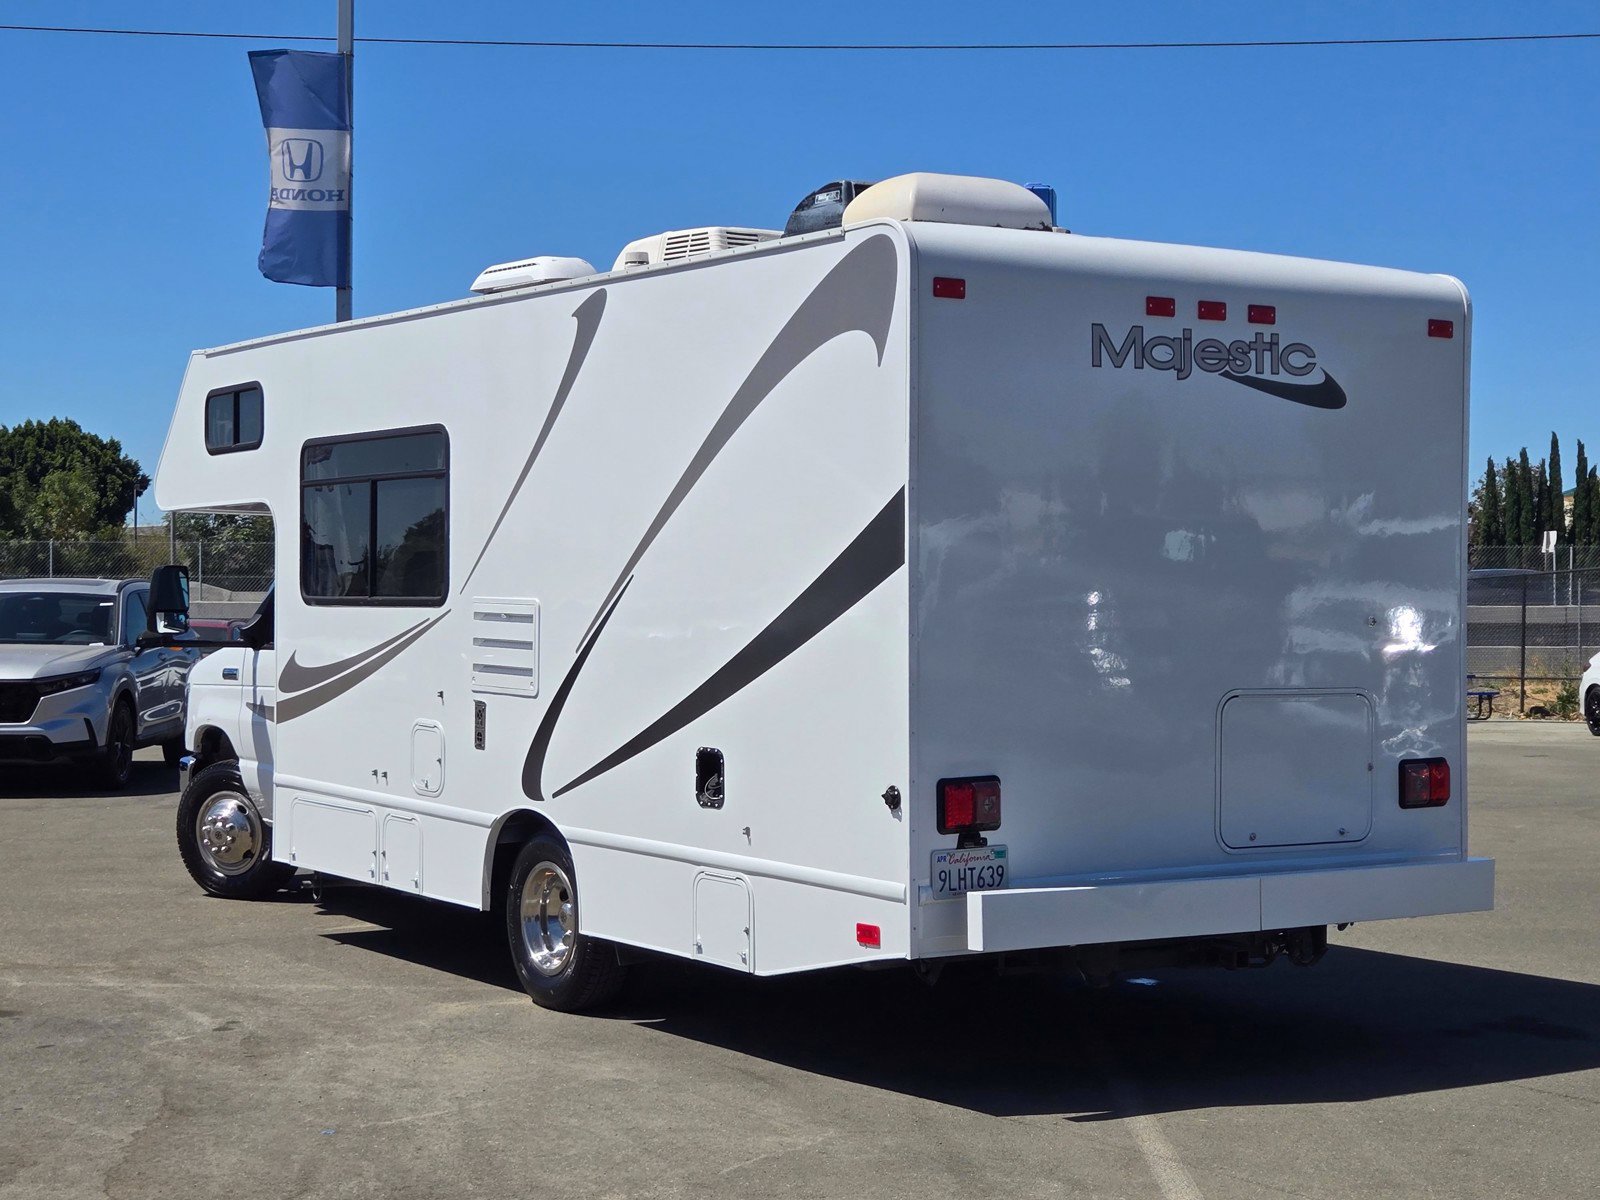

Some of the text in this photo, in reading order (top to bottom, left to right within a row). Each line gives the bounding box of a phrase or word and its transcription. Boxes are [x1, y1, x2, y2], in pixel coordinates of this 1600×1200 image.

[1091, 322, 1317, 381] Majestic
[936, 855, 947, 863] APR
[947, 852, 995, 867] California
[938, 865, 1005, 892] 9LHT639
